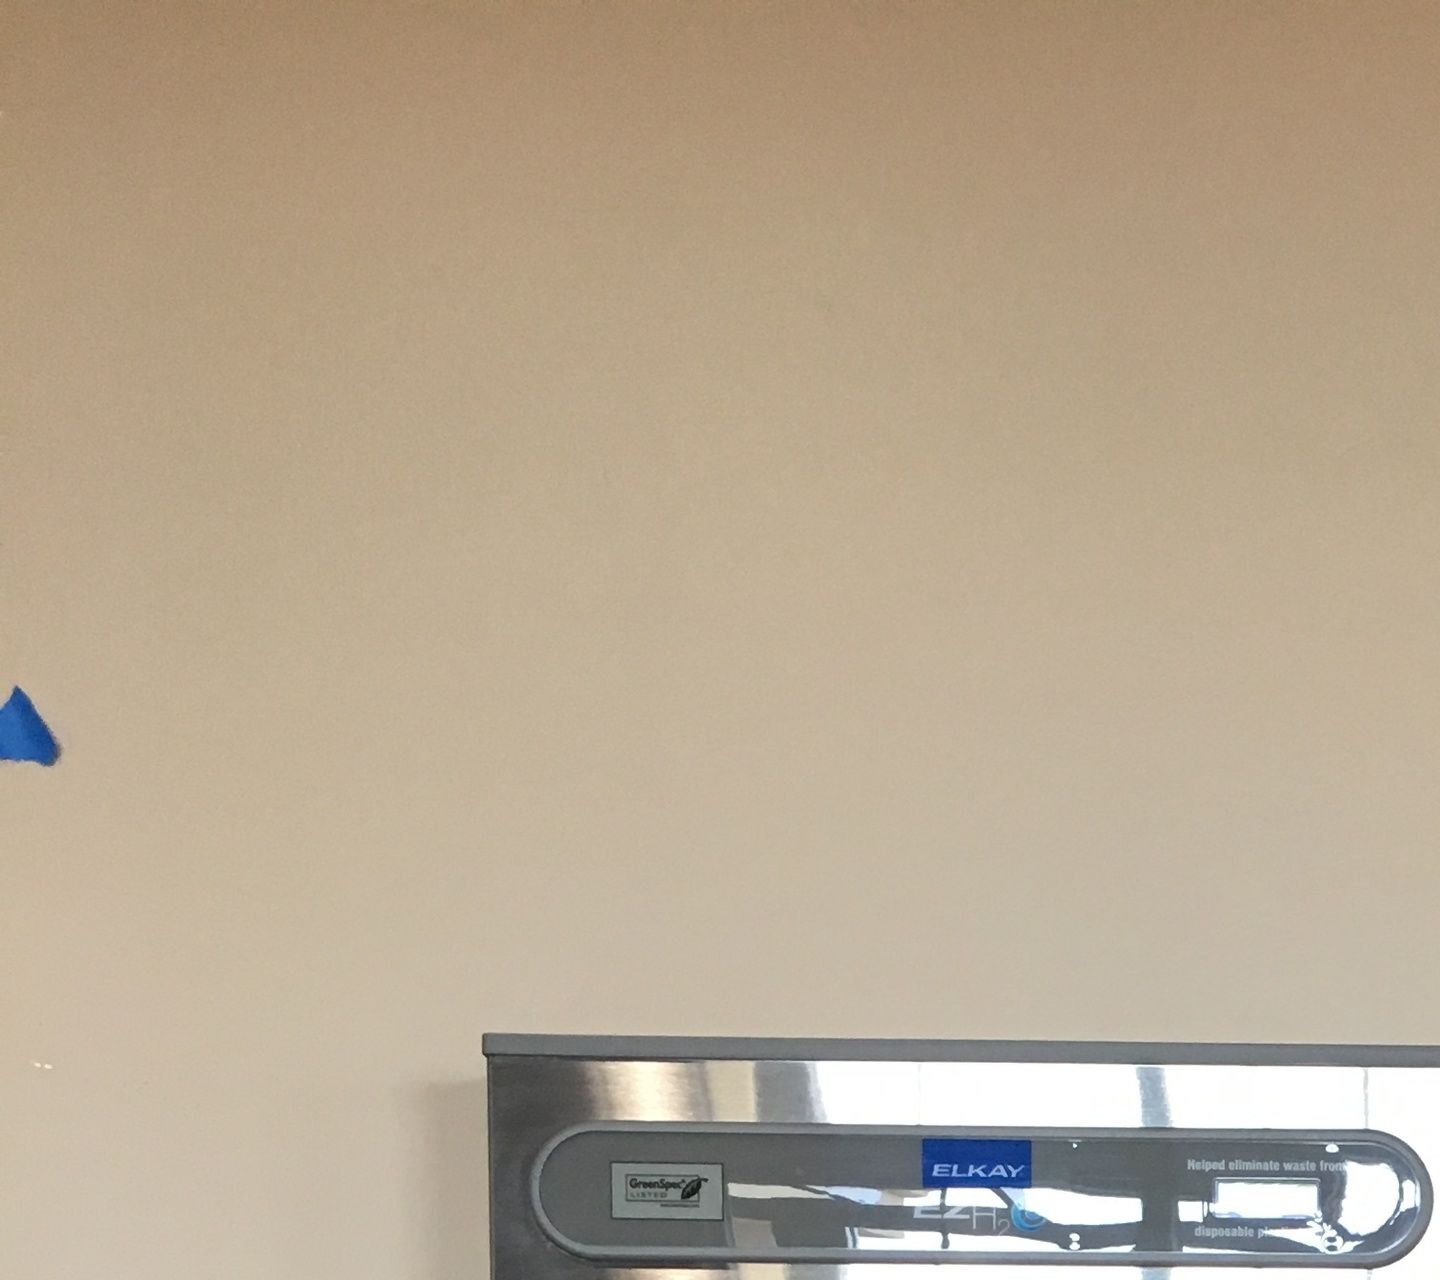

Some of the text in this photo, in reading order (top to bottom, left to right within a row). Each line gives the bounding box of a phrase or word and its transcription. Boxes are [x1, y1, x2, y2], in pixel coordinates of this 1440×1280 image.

[932, 1163, 1025, 1178] ELKAY
[1187, 1158, 1347, 1173] Helped eliminate waste from
[1194, 1226, 1255, 1239] disposable
